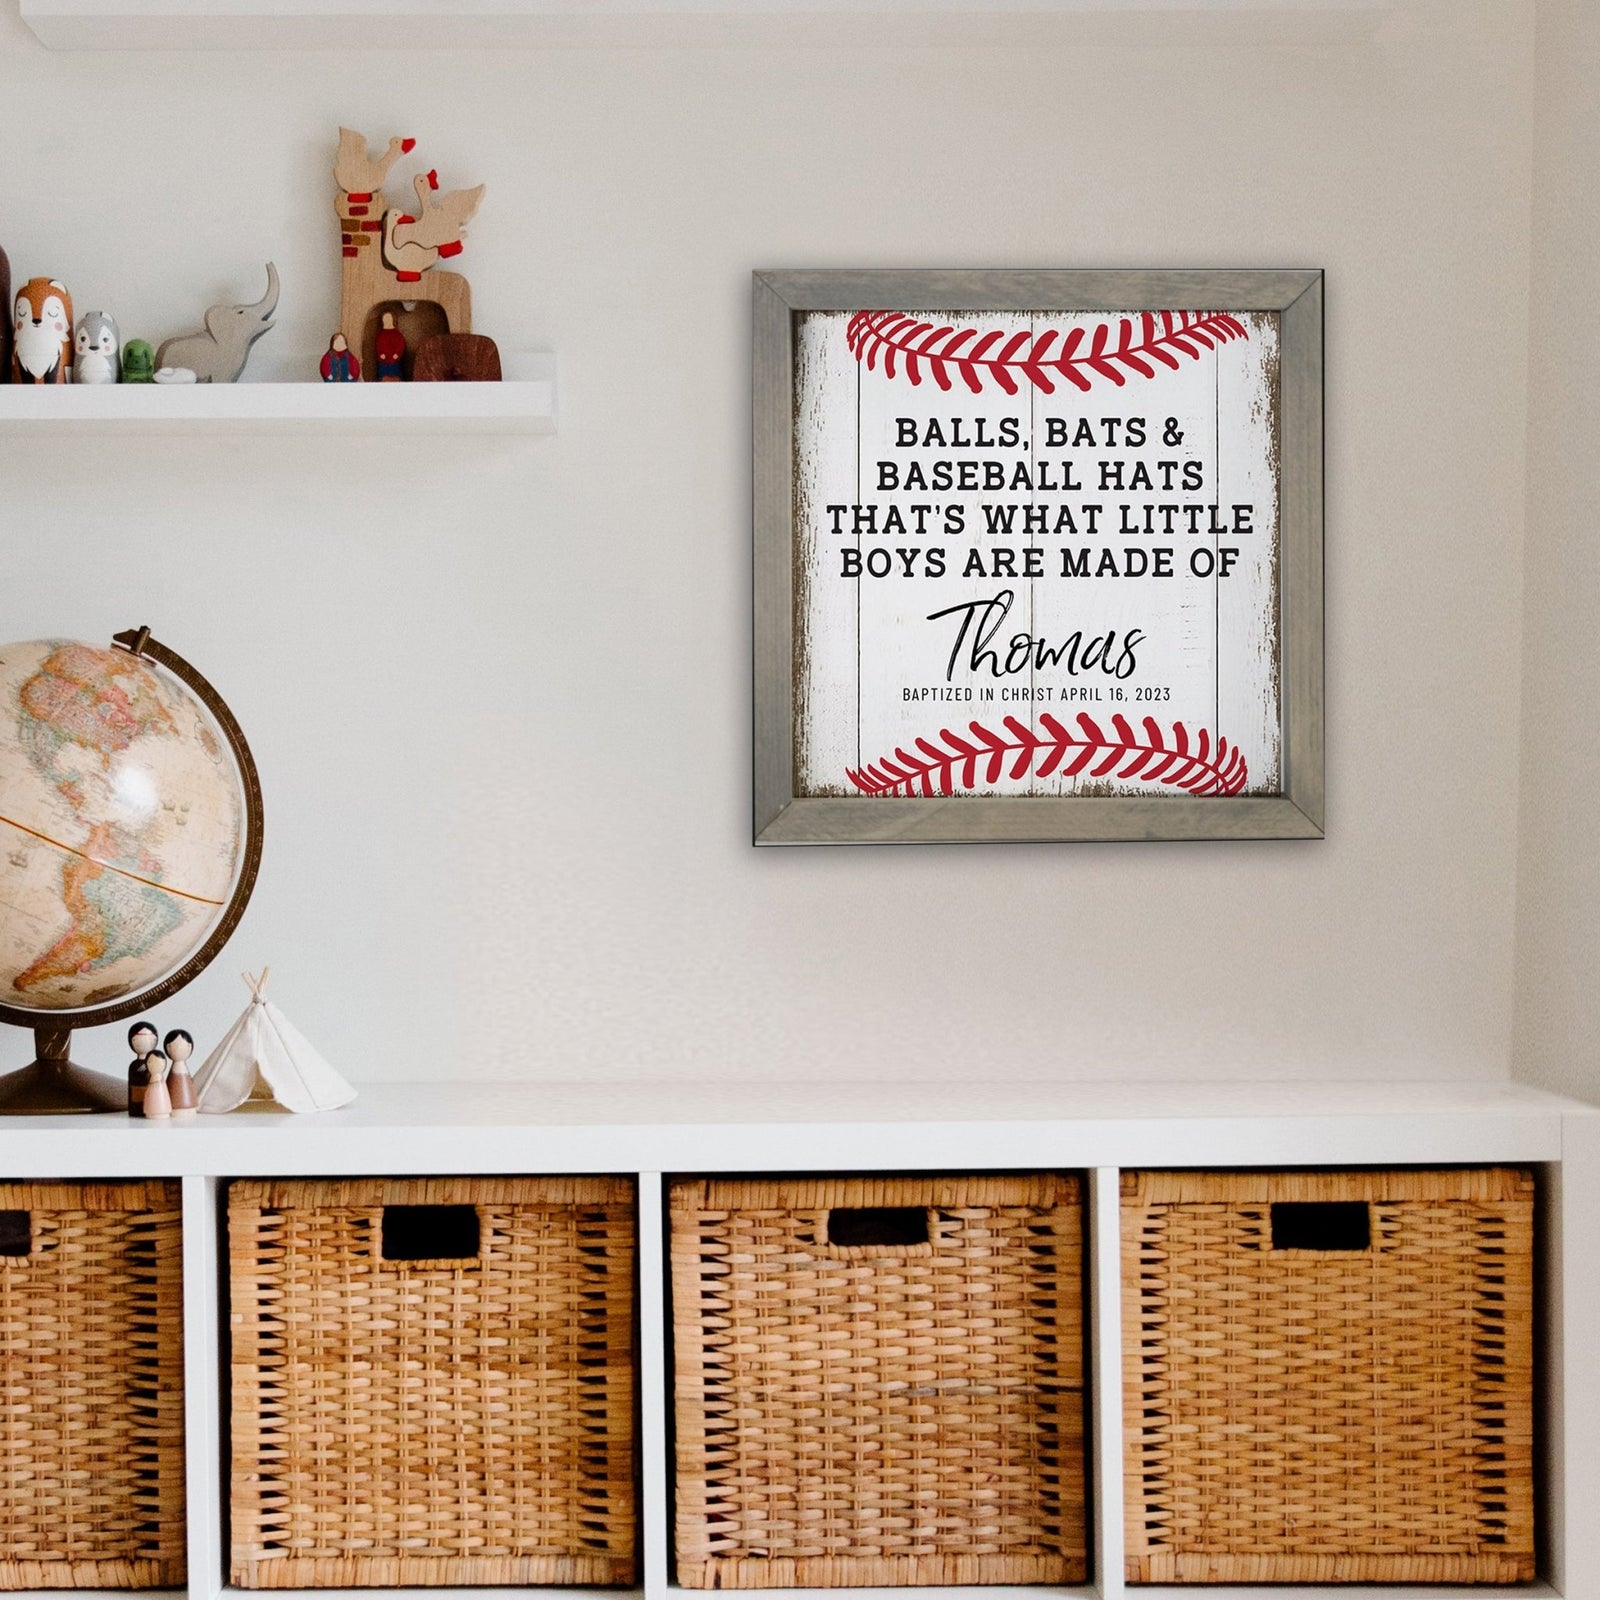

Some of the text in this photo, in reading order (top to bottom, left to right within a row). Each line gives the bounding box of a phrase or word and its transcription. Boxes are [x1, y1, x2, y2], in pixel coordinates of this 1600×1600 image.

[895, 417, 1185, 451] BALLS, BATS &
[877, 461, 1203, 491] BASEBALL HATS
[827, 504, 1254, 535] THAT'S WHAT LITTLE
[840, 548, 1240, 578] BOYS ARE MADE OF
[926, 589, 1147, 682] Thomas
[903, 688, 1171, 704] BAPTIZED IN CHRIST APRIL 16, 2023
